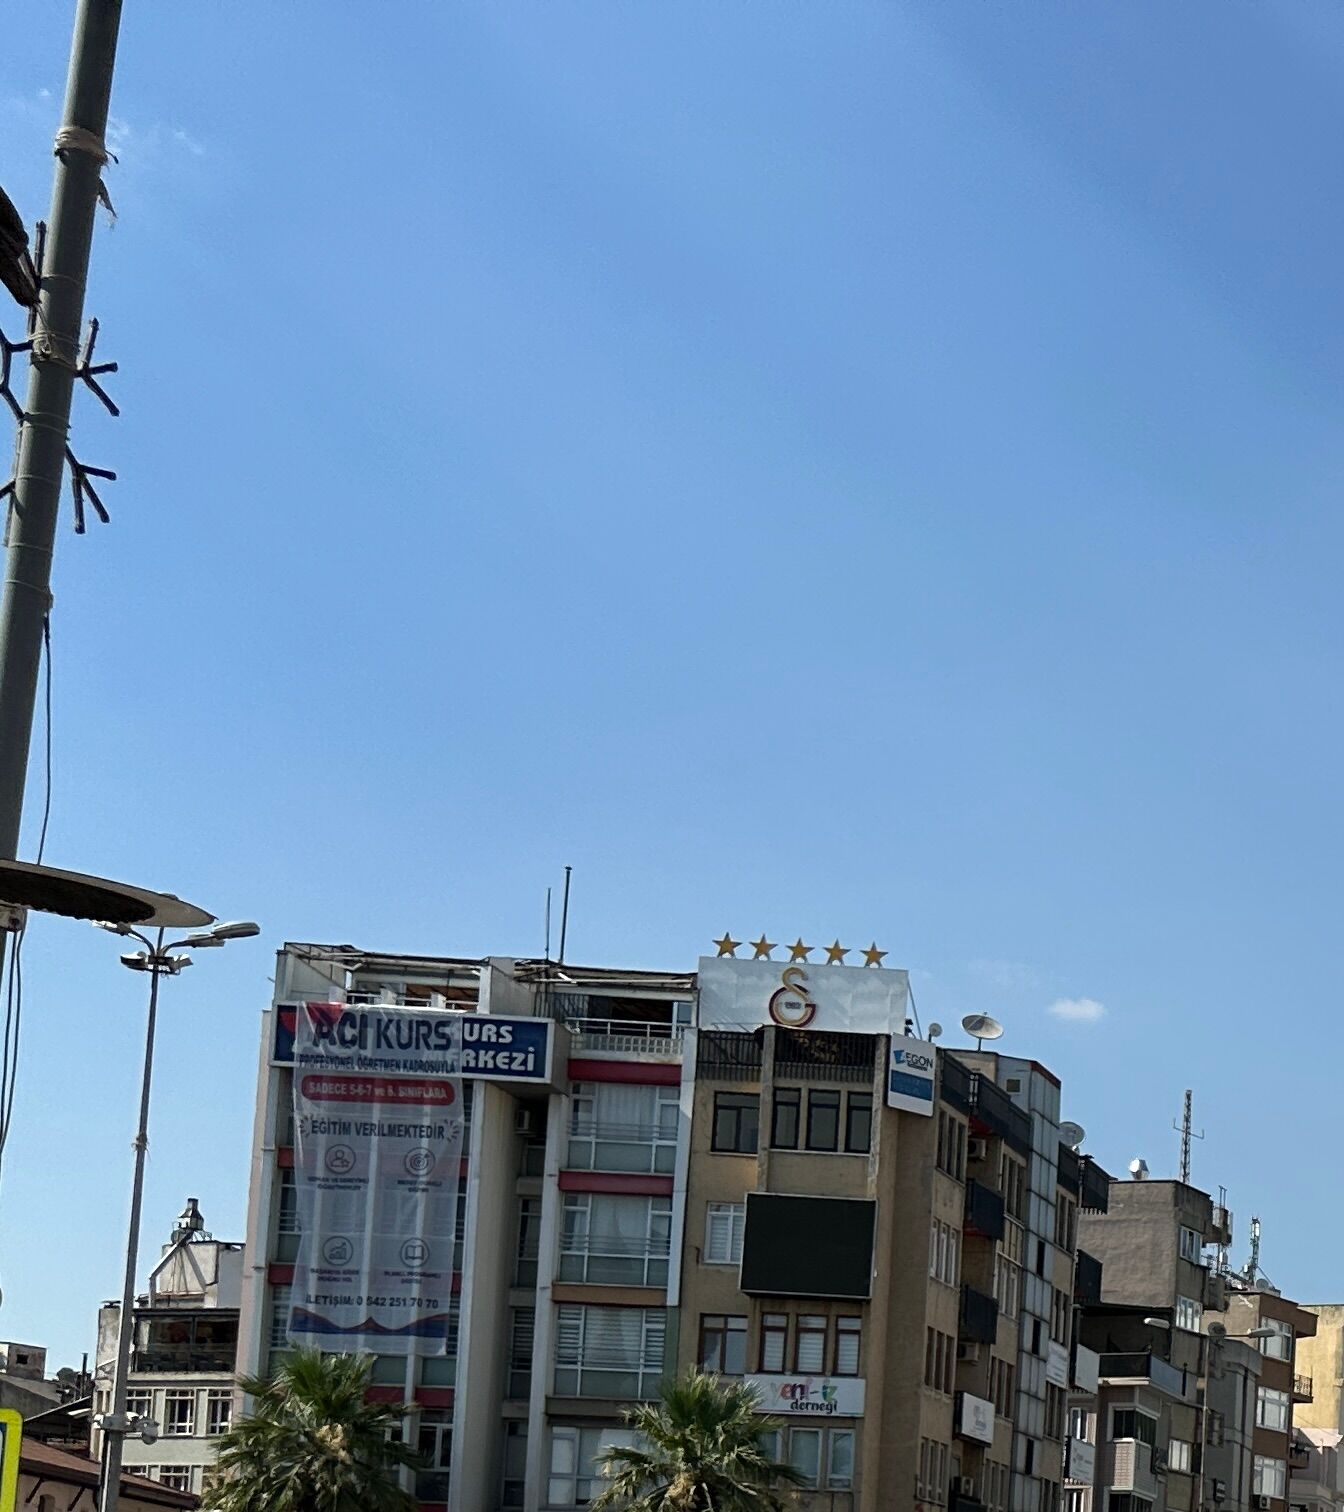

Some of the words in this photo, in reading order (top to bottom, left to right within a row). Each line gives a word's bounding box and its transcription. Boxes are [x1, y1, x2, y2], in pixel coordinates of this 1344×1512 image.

[376, 1018, 452, 1051] KURS
[463, 1023, 513, 1043] URS
[308, 1081, 347, 1096] SADECE
[311, 1117, 351, 1135] EĞİTİM
[354, 1121, 445, 1140] VERİLMEKTEDİR
[410, 1298, 422, 1308] 70
[425, 1299, 439, 1309] 70
